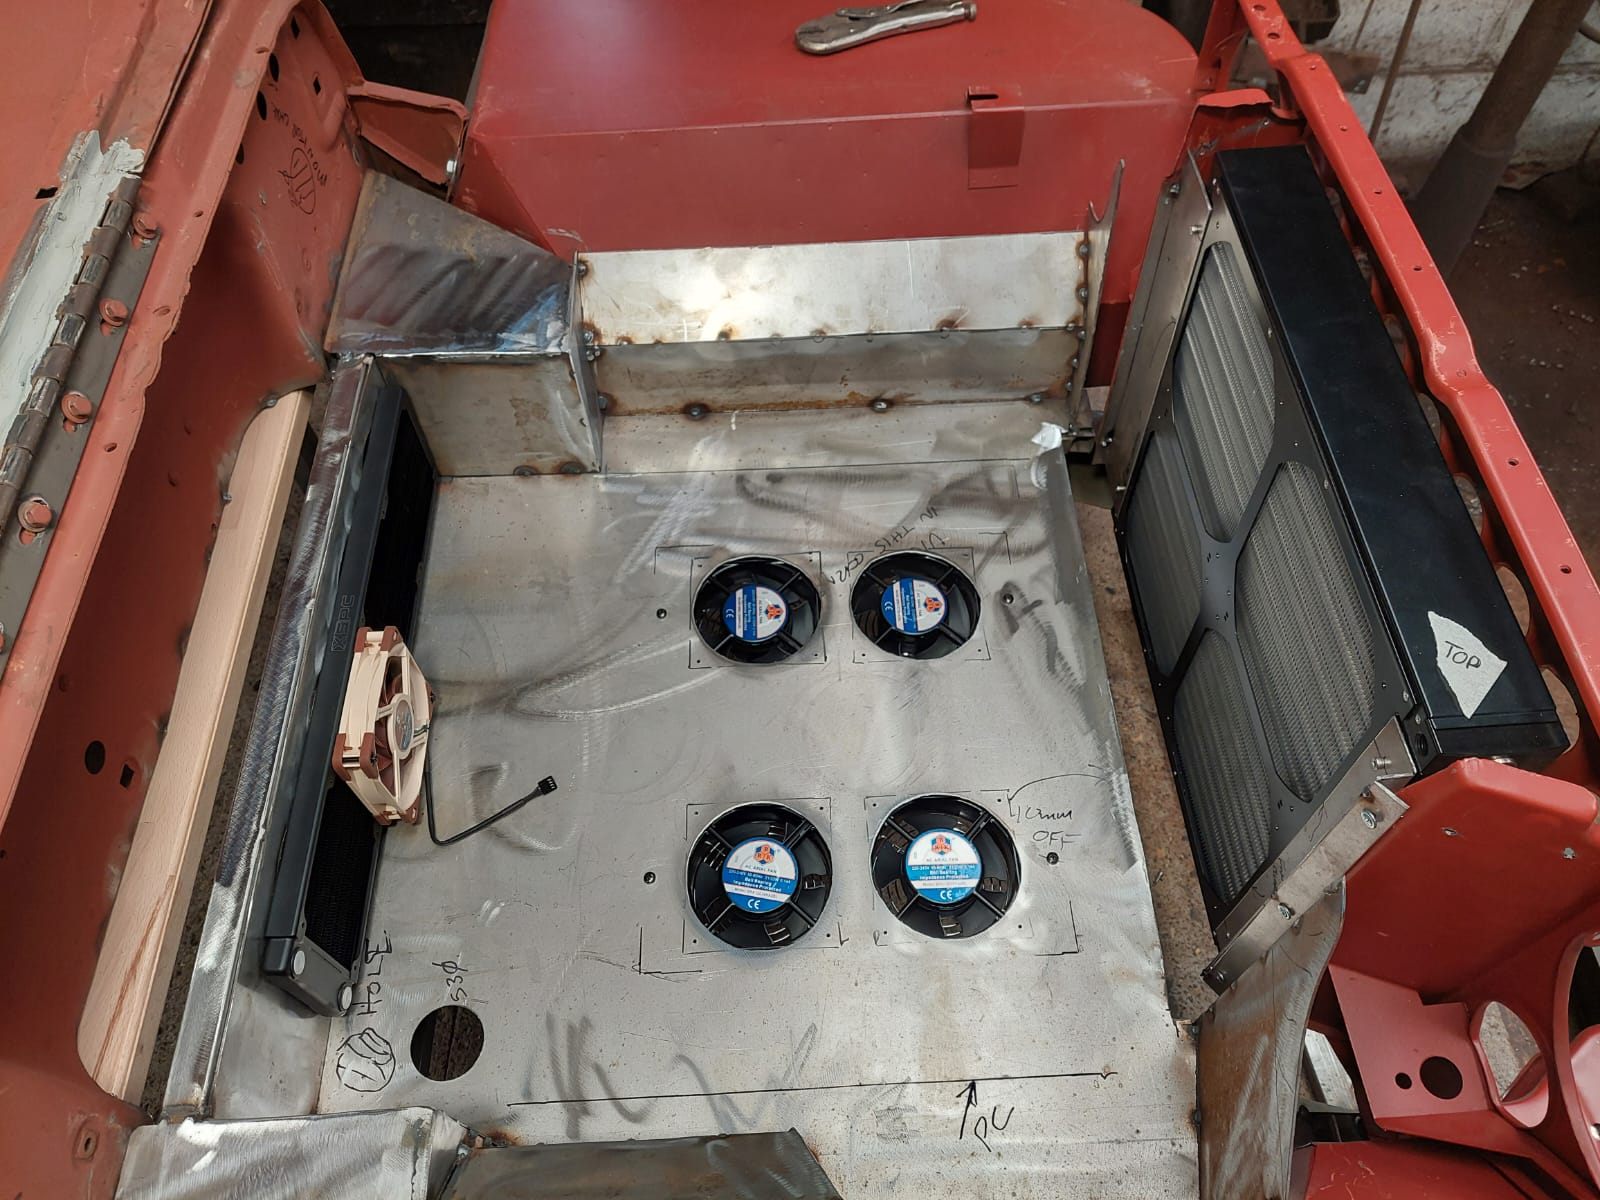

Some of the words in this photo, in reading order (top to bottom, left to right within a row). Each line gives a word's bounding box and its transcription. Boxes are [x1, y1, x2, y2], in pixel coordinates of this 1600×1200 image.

[874, 525, 915, 554] THIS
[725, 608, 735, 618] CE
[884, 601, 894, 611] CE
[1444, 640, 1482, 669] TOP
[1032, 830, 1082, 850] OFF
[940, 890, 953, 900] CE
[747, 898, 761, 909] CE
[351, 929, 393, 1015] HOLE
